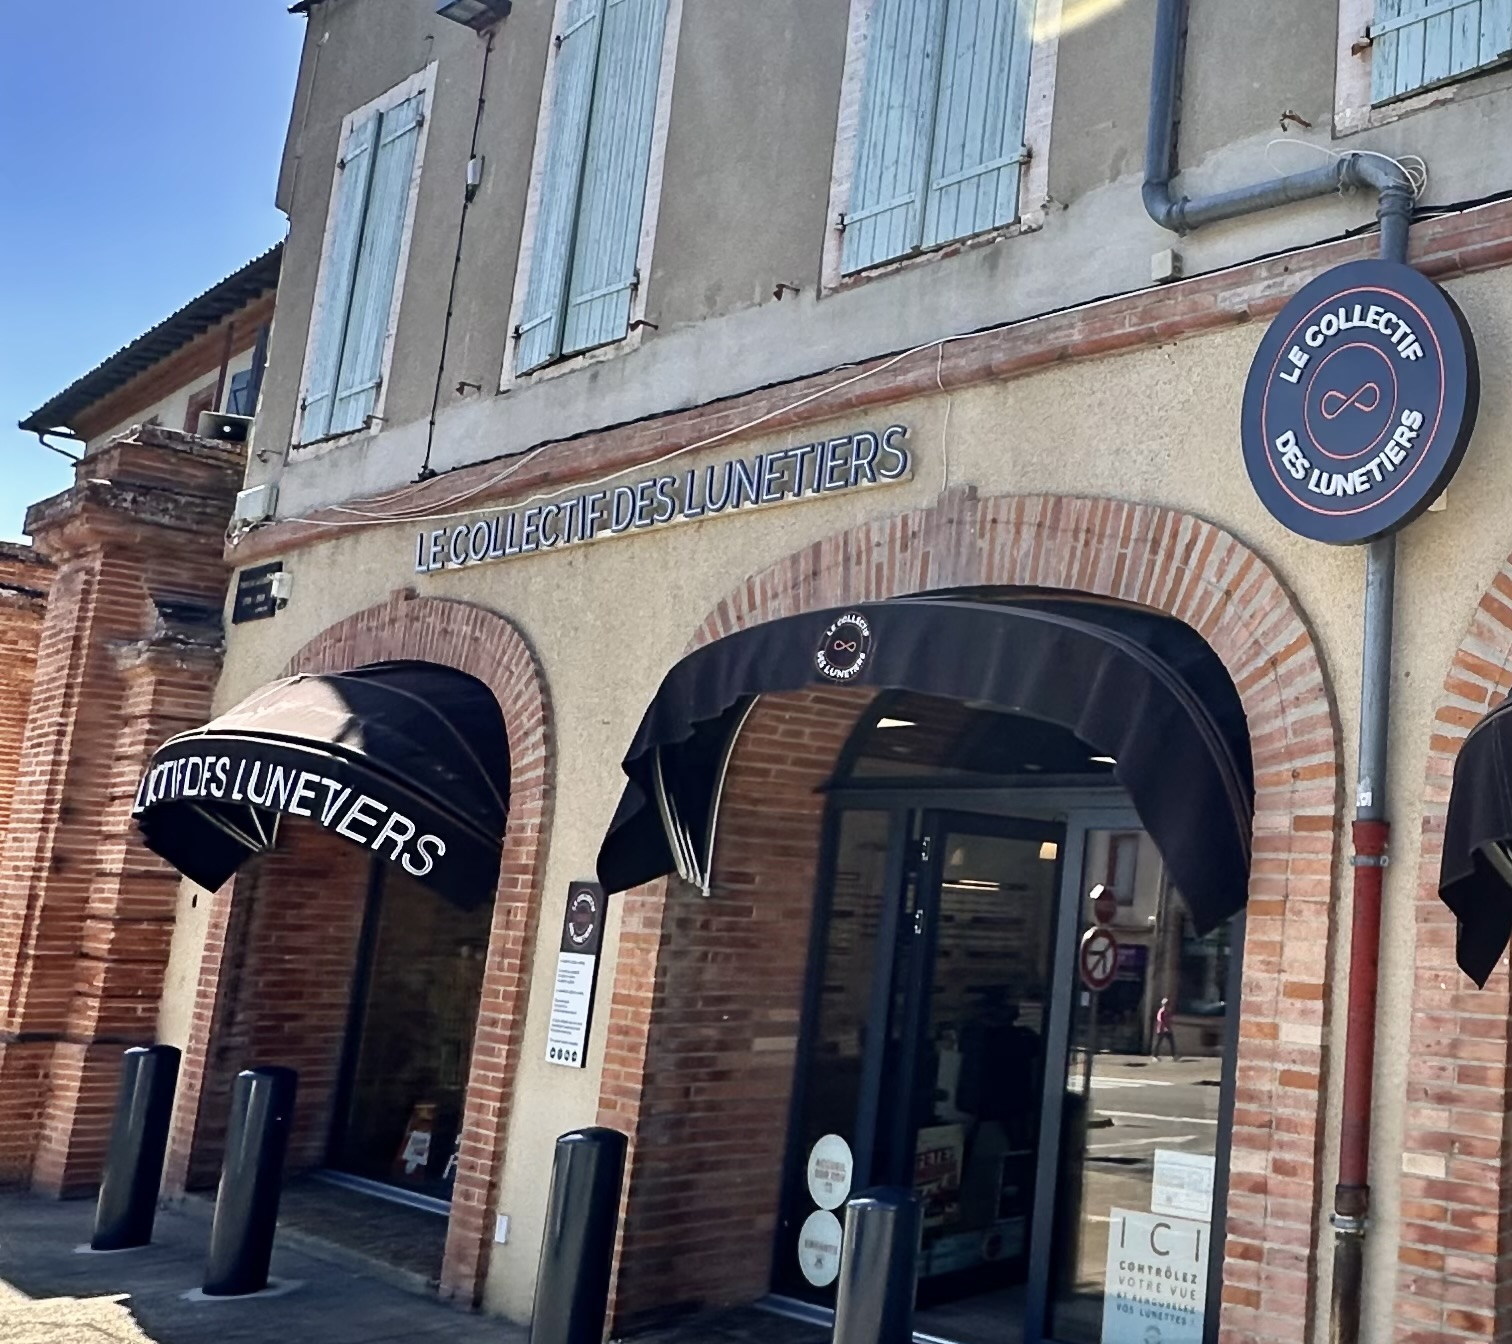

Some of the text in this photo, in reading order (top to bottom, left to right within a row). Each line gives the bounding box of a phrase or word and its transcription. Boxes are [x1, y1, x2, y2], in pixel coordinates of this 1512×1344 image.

[1280, 305, 1423, 383] LE COLLECTIF
[1276, 409, 1424, 497] DES LUNETIERS
[415, 424, 909, 573] LE COLLECTIF DES LUNETIERS
[183, 756, 230, 797] DES
[232, 759, 446, 876] LUNETIERS
[1120, 1216, 1201, 1262] ICI
[1118, 1276, 1196, 1300] VOTRE VUE
[1119, 1260, 1197, 1284] CONTRÔLEZ
[1116, 1303, 1134, 1314] VOS
[1139, 1308, 1187, 1326] LUNETTES
